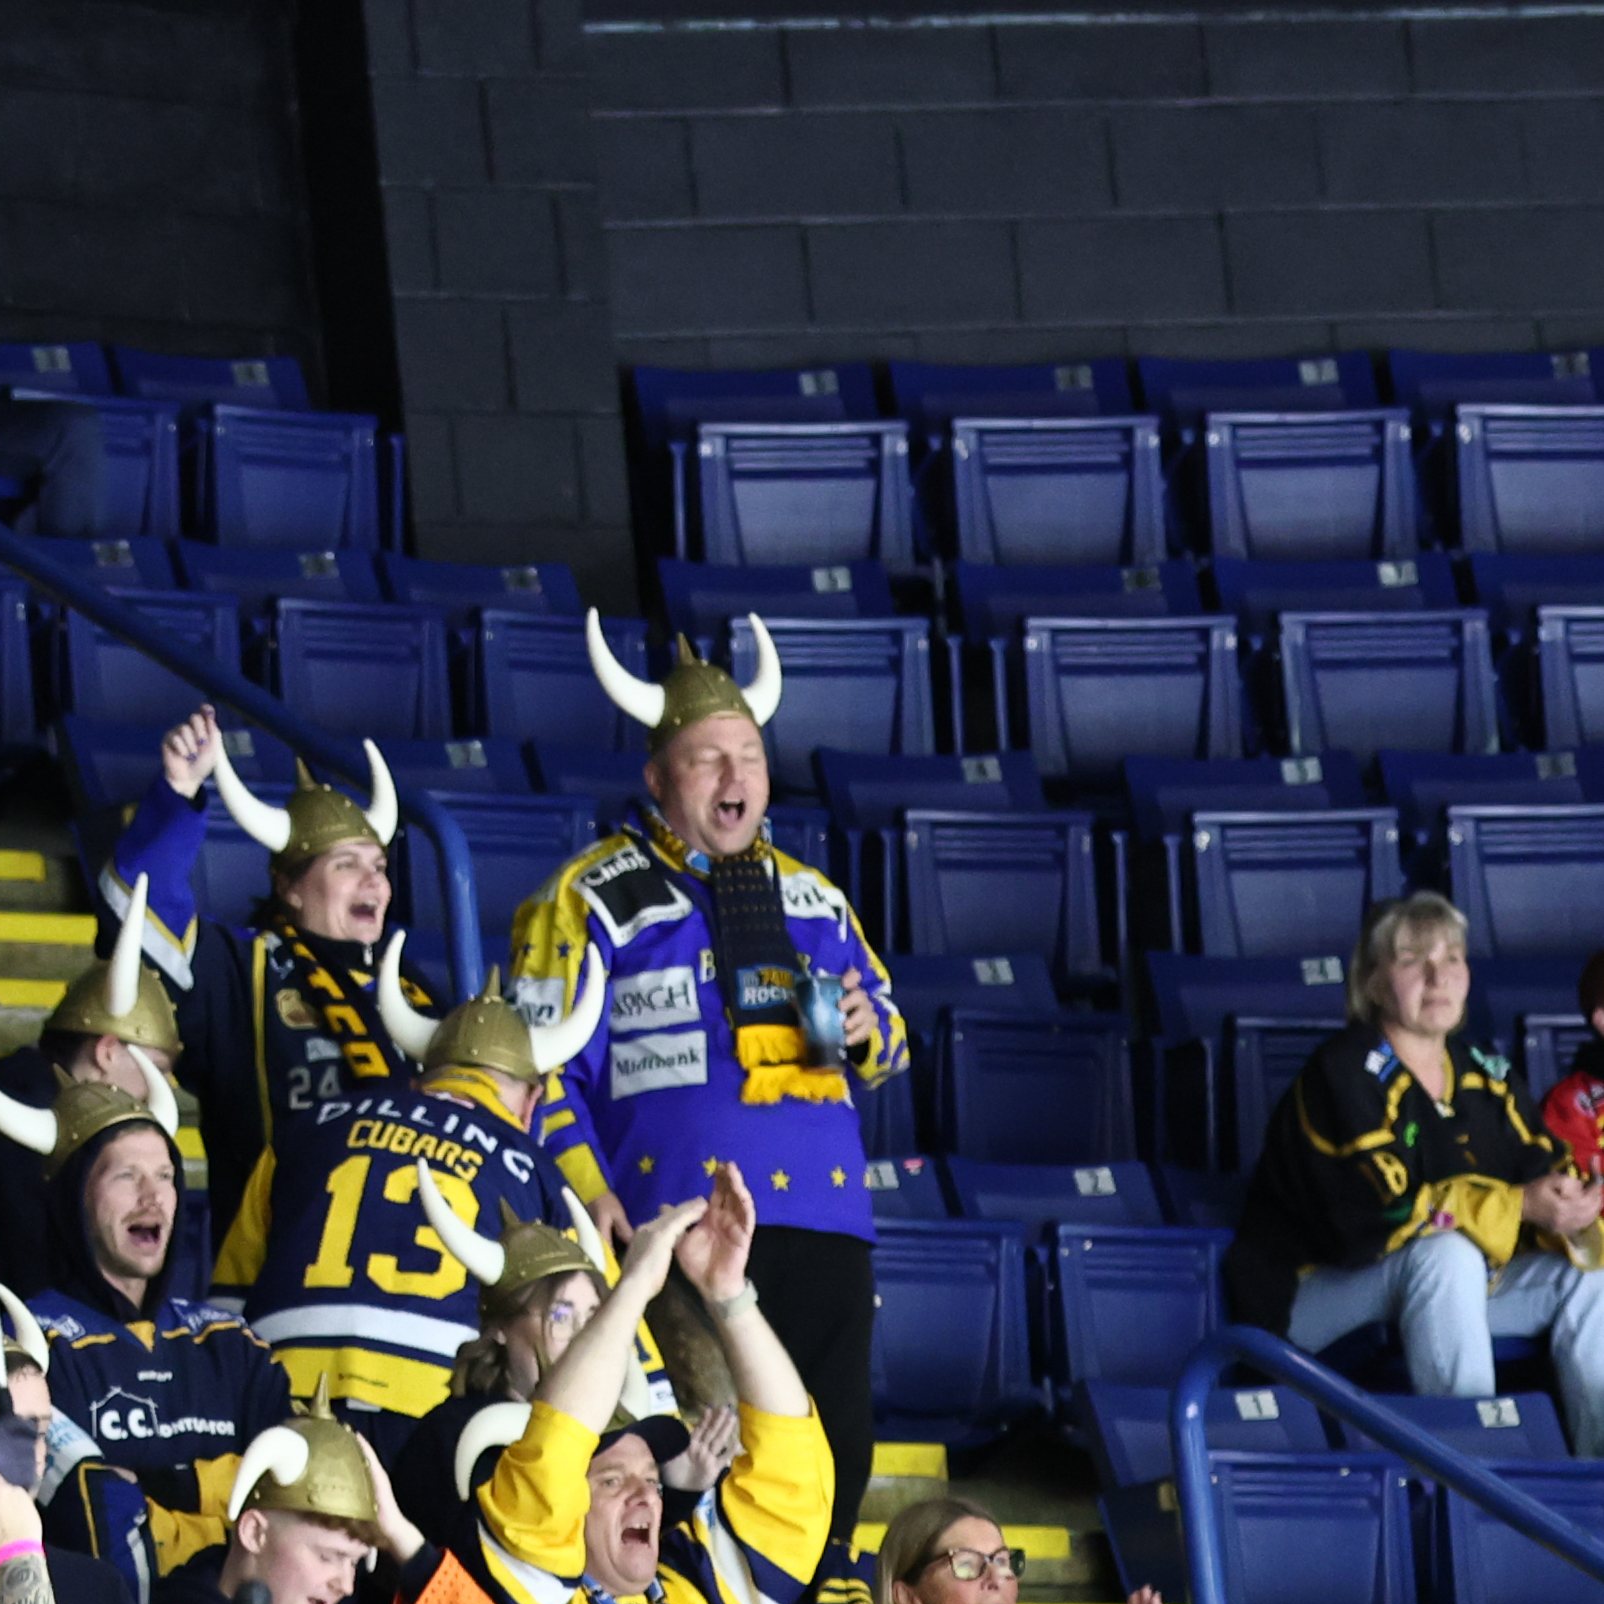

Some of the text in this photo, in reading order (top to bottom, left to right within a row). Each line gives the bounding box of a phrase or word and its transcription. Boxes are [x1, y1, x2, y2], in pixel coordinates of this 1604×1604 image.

[316, 1096, 536, 1186] DILLING
[346, 1119, 484, 1186] CUBARS
[303, 1154, 480, 1301] 13
